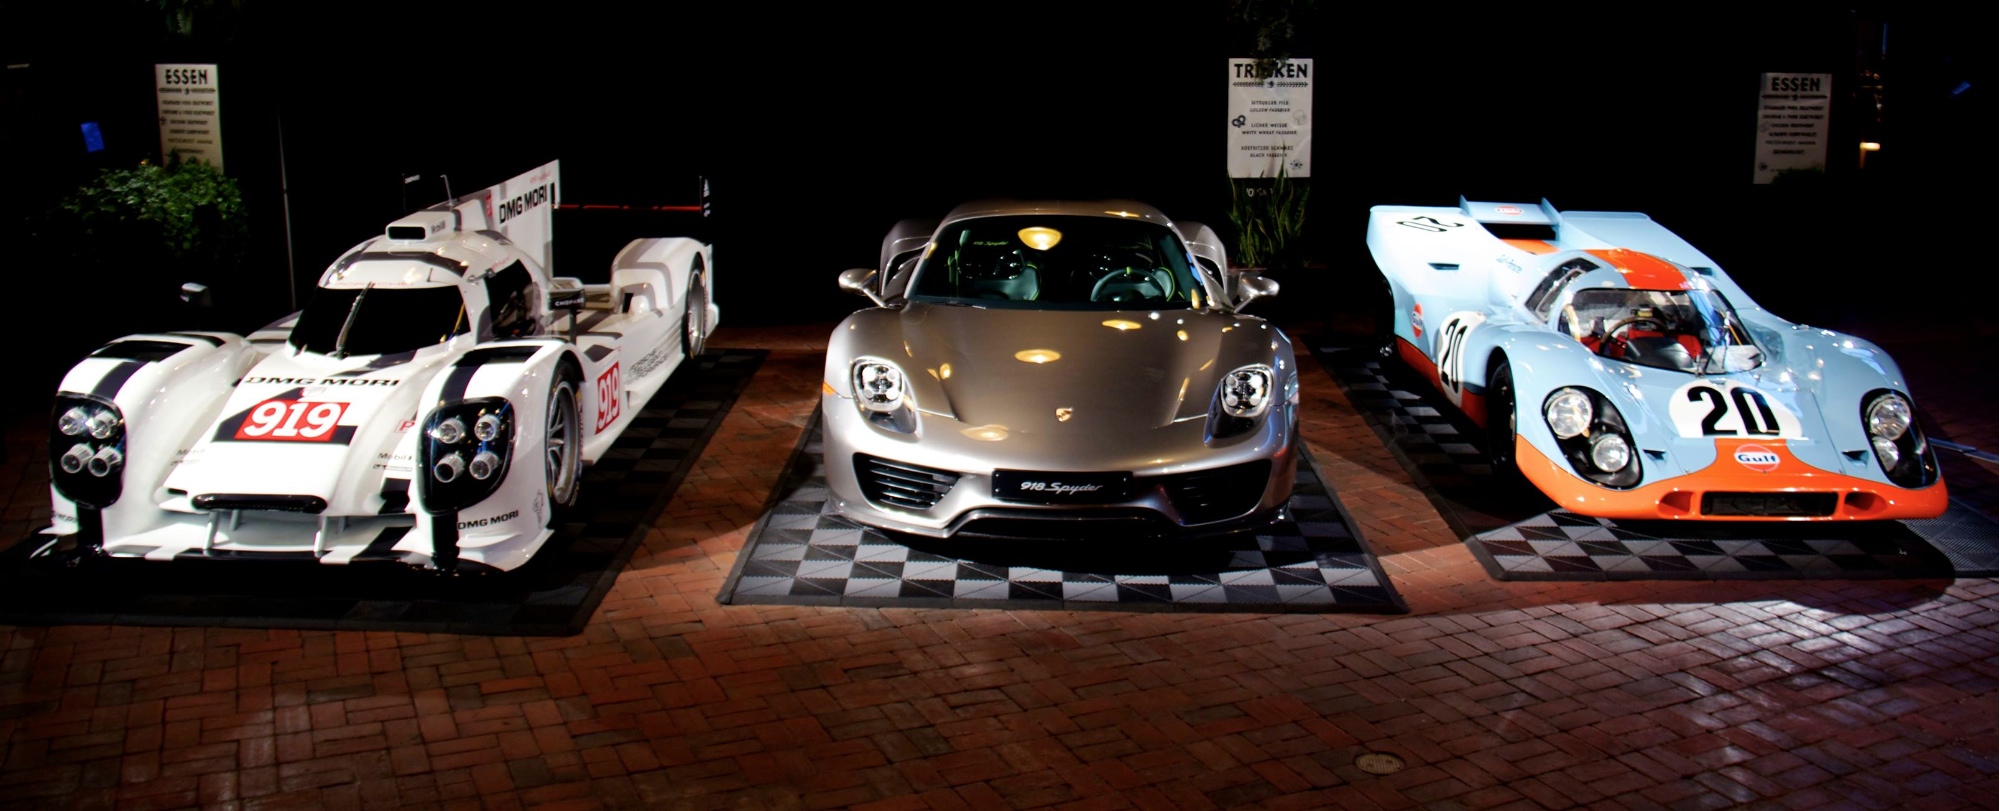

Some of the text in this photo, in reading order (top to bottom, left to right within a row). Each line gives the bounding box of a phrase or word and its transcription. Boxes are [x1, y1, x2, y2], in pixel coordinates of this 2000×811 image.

[165, 69, 208, 84] ESSEN
[1234, 64, 1308, 78] TRIKEN
[1771, 77, 1821, 91] ESSEN
[500, 196, 523, 224] DMG
[524, 183, 548, 212] MORI
[1441, 318, 1468, 394] 20
[245, 377, 400, 387] DMG MORI
[598, 366, 619, 430] 919
[243, 400, 342, 439] 919
[1687, 386, 1780, 436] 20
[1737, 454, 1777, 463] Gulf
[1020, 482, 1103, 495] 918 Spyder
[457, 510, 519, 530] DMG MORI
